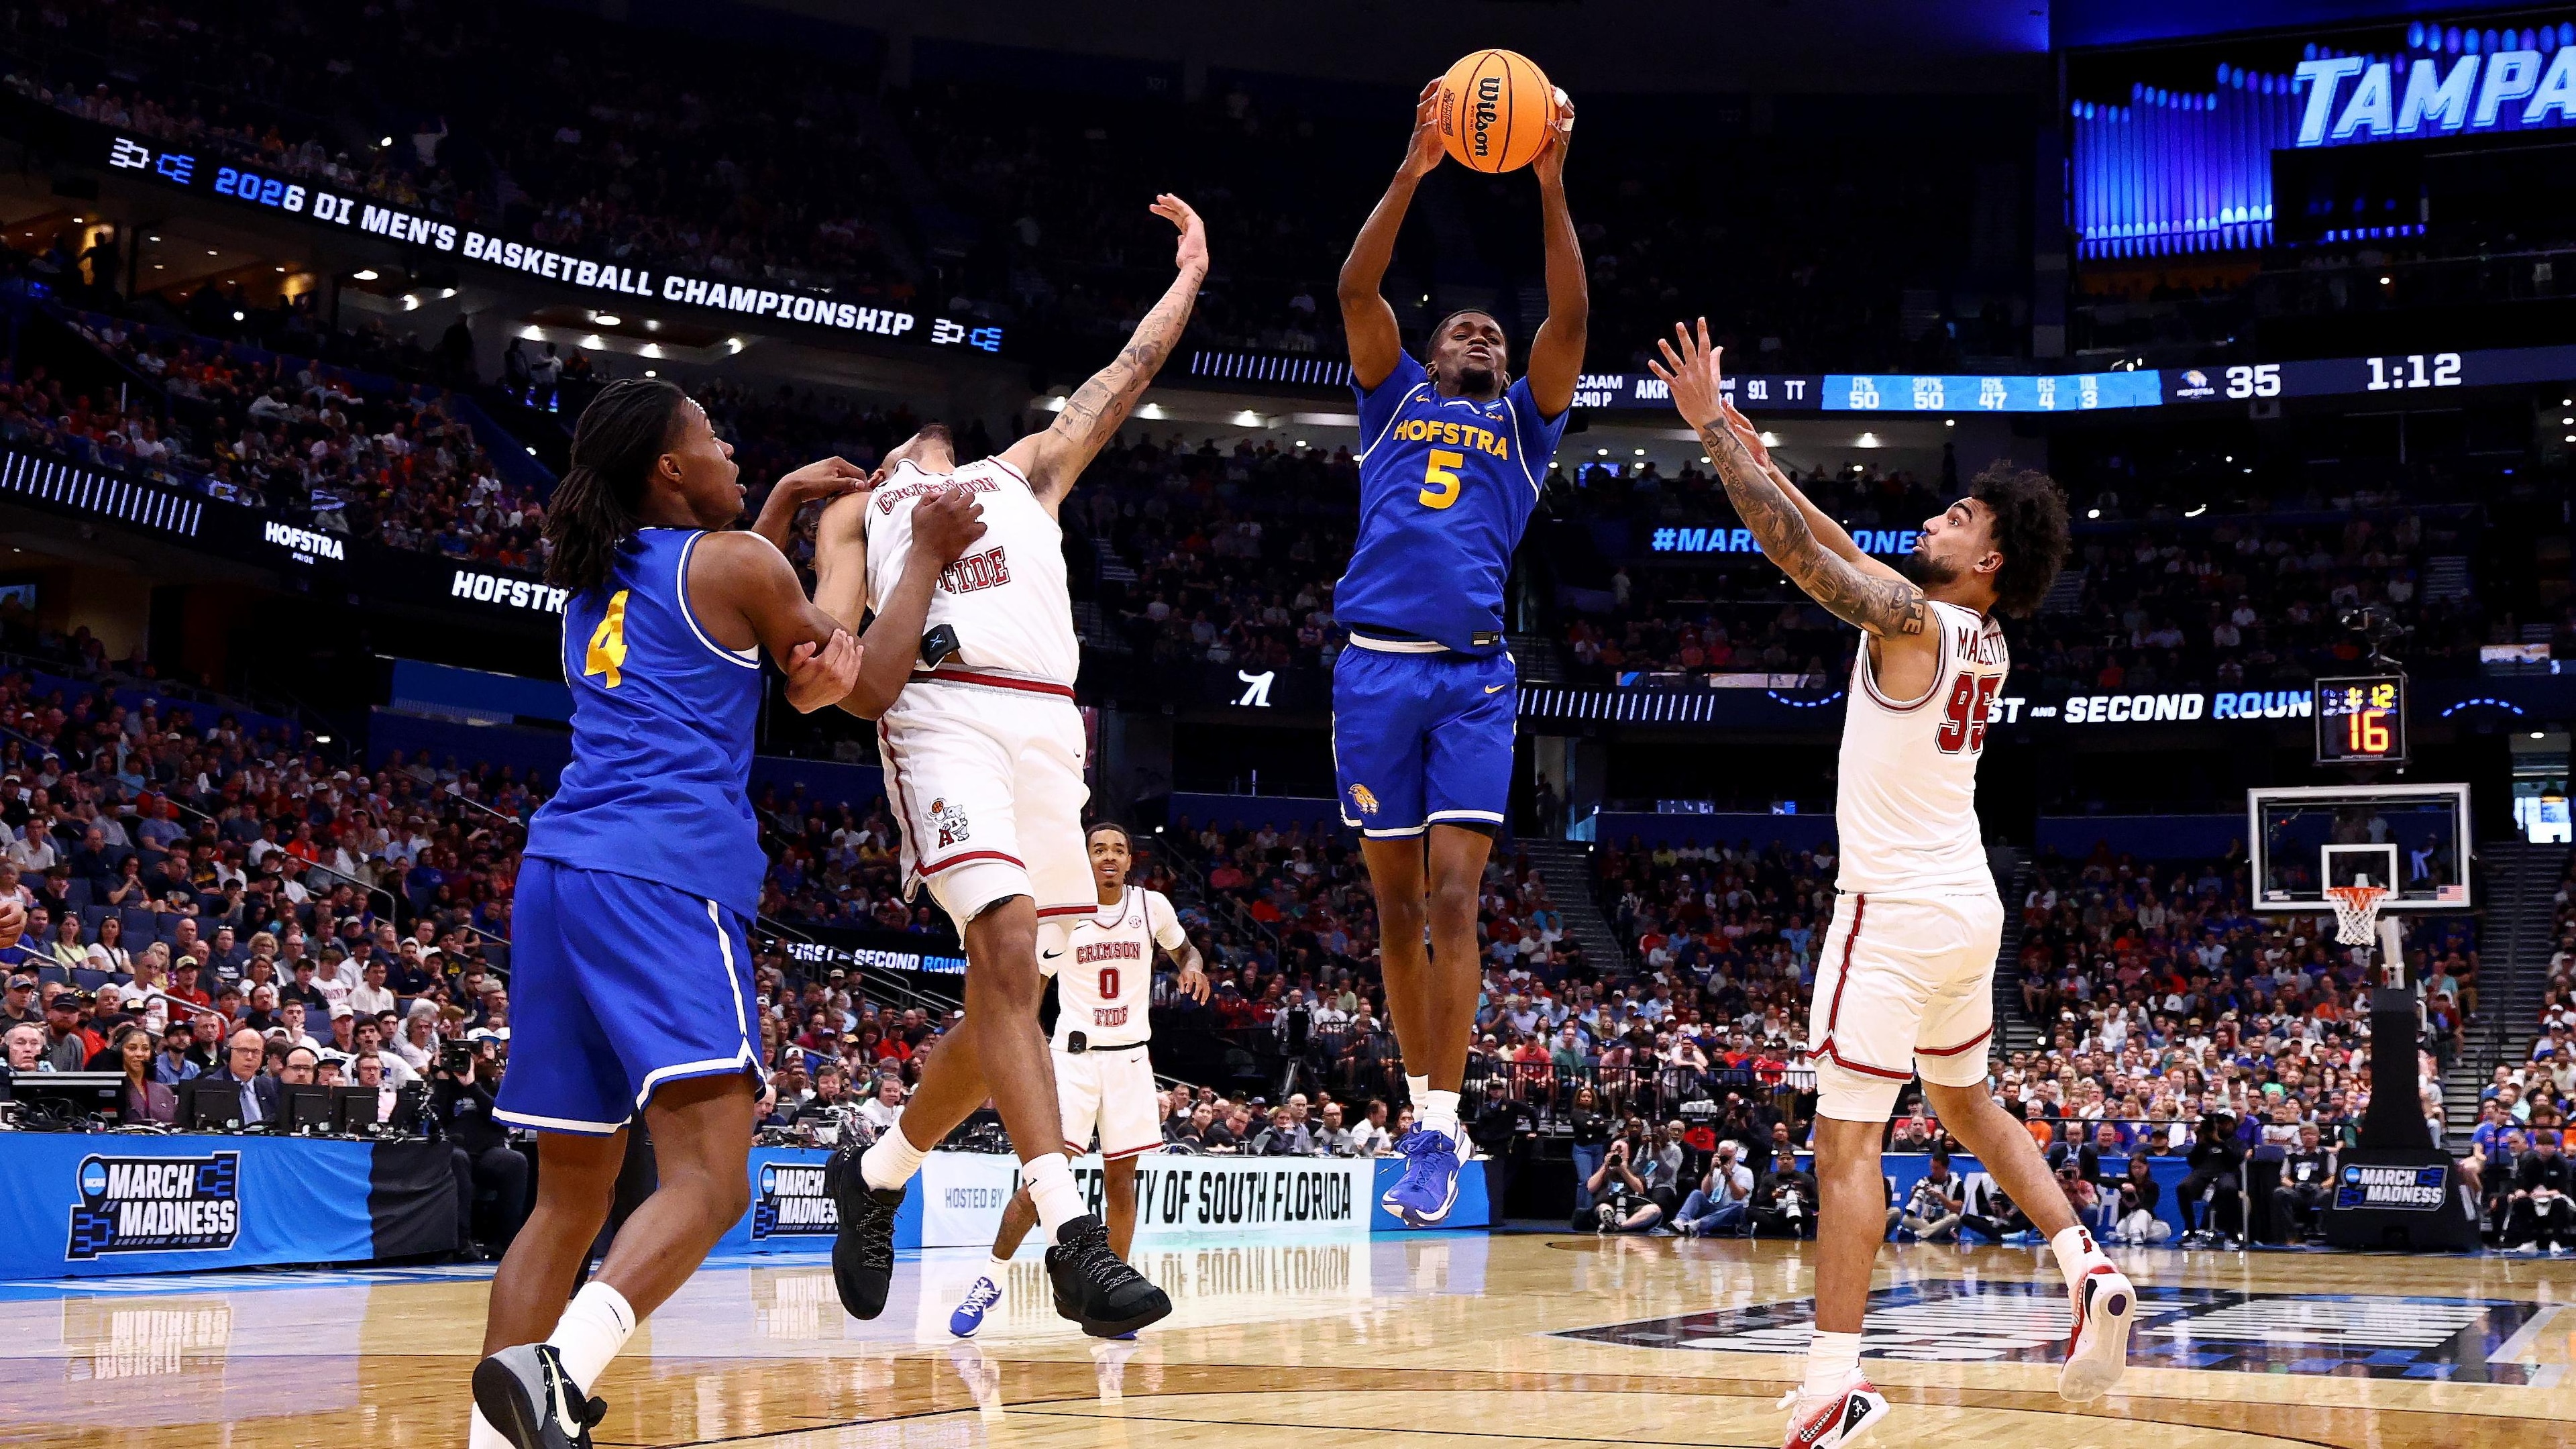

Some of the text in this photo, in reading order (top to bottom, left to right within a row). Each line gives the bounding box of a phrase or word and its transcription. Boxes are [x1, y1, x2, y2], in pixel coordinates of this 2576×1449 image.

[2296, 46, 2576, 148] TAMPA
[1475, 76, 1501, 156] Wilson
[215, 168, 914, 335] 2026 DI MEN'S BASKETBALL CHAMPIONSHIP
[1576, 374, 1623, 389] CAAM
[2225, 364, 2281, 398] 35
[2366, 353, 2462, 390] 1:12
[1635, 379, 1669, 399] AKR
[1748, 380, 1768, 400] 91
[1784, 380, 1806, 400] TT
[1849, 391, 1880, 409] 50
[1914, 391, 1944, 410] 50
[1978, 392, 2008, 410] 47
[2039, 392, 2055, 411] 4
[2082, 390, 2098, 409] 3
[1393, 420, 1508, 461] HOFSTRA
[1419, 448, 1464, 509] 5
[265, 521, 344, 561] HOFSTRA
[451, 570, 566, 614] HOFSTR
[584, 588, 629, 690] 4
[2030, 706, 2057, 717] AND
[2064, 693, 2204, 723] SECOND
[2212, 690, 2312, 720] ROUN
[2350, 709, 2389, 752] 16
[854, 949, 966, 975] SECOND ROUN
[1076, 941, 1140, 965] CRIMSON
[1098, 967, 1121, 1000] 0
[1092, 1005, 1128, 1028] TIDE
[107, 1164, 195, 1199] MARCH
[774, 1169, 825, 1196] MARCH
[2359, 1168, 2416, 1186] MARCH
[945, 1187, 1004, 1208] HOSTED BY
[1163, 1170, 1192, 1224] OF
[1198, 1171, 1267, 1224] SOUTH
[1273, 1171, 1351, 1222] FLORIDA
[2366, 1185, 2443, 1204] MADNESS
[119, 1200, 235, 1236] MADNESS
[778, 1197, 839, 1224] MADNES
